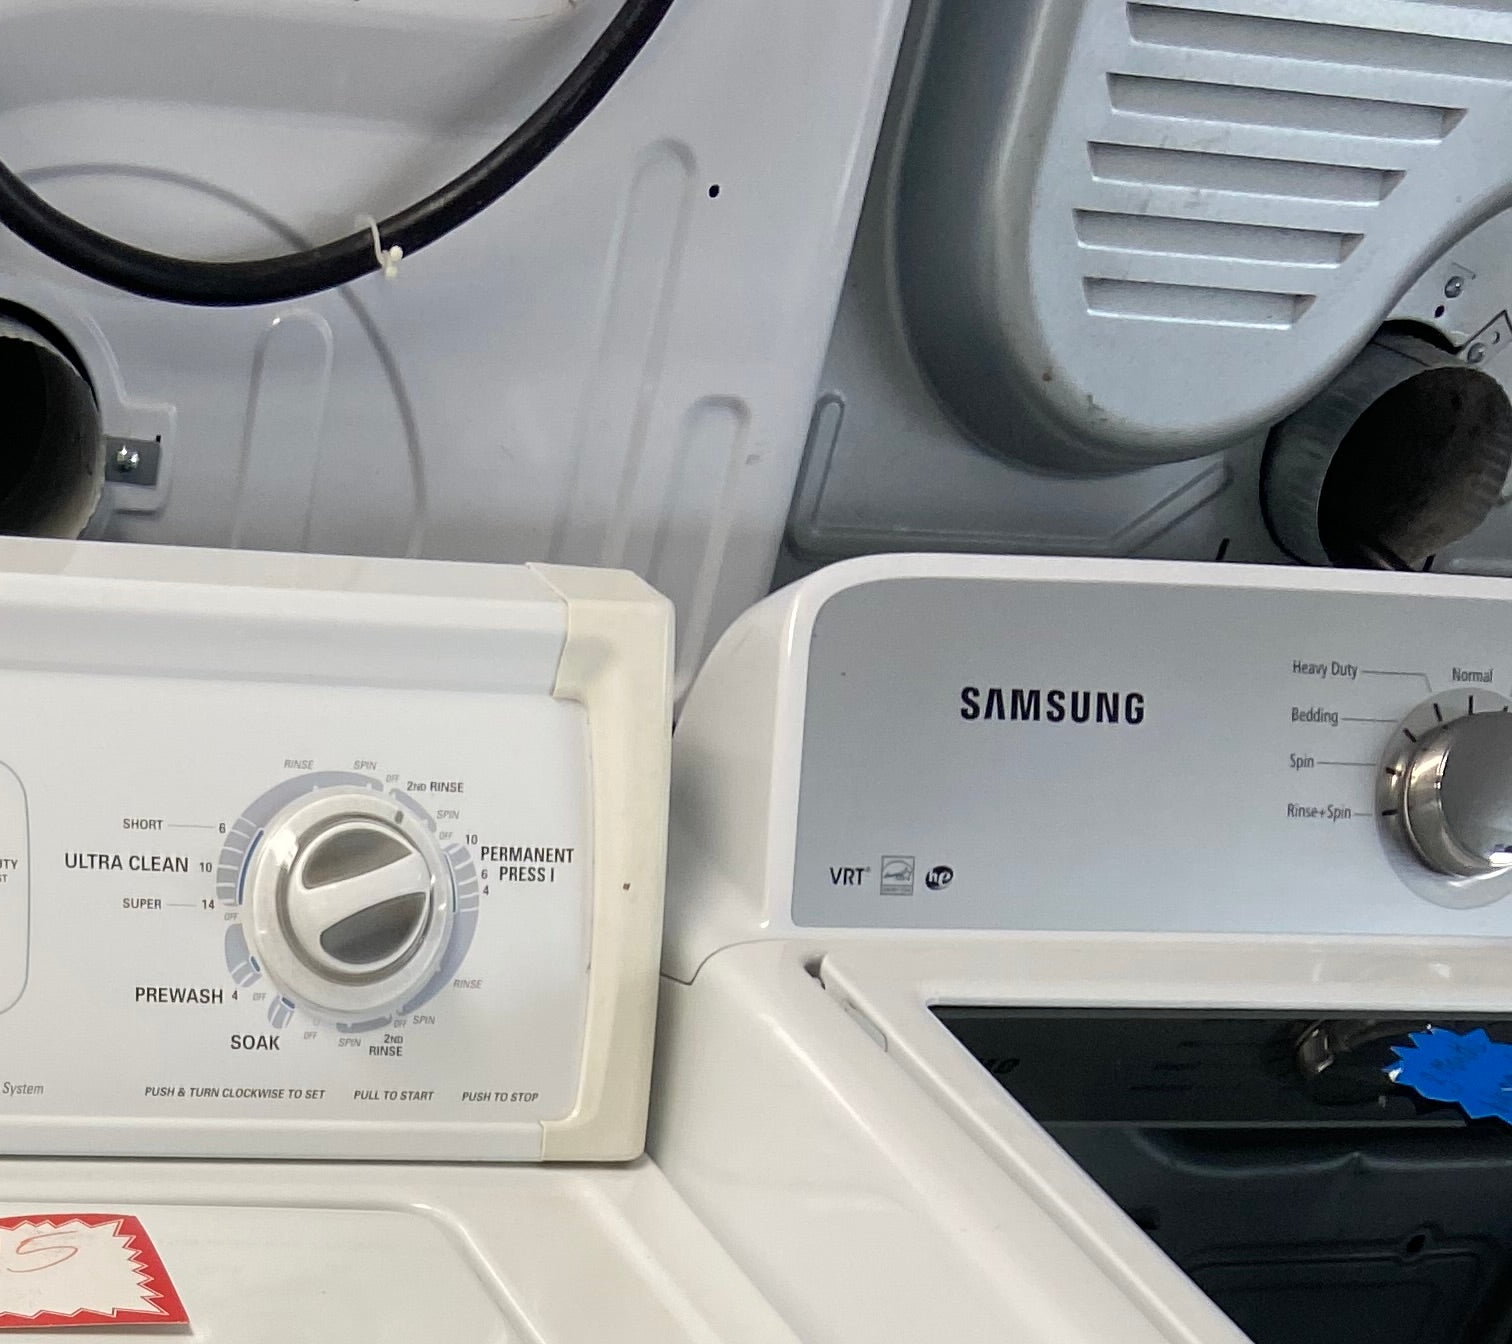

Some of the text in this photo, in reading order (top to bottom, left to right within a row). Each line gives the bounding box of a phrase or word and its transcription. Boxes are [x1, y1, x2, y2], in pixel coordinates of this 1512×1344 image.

[1292, 660, 1358, 680] Heavy Duty
[1452, 667, 1493, 682] Normal
[959, 686, 1145, 725] SAMSUNG
[1292, 707, 1338, 727] Bedding
[284, 760, 377, 770] RINSE SPIN
[1290, 753, 1314, 771] Spin
[407, 781, 464, 793] 2ND RINSE
[436, 810, 460, 819] SPIN
[1287, 803, 1351, 822] Rinse+Spin
[123, 819, 163, 830] SHORT
[465, 835, 478, 845] 10
[481, 846, 574, 863] PERMANENT
[65, 853, 212, 872] ULTRA CLEAN 10
[481, 869, 488, 879] 6
[500, 866, 545, 882] PRESS
[830, 867, 864, 885] VRT
[483, 885, 489, 895] 4
[123, 898, 215, 909] SUPER 14
[454, 980, 482, 989] RINSE
[136, 987, 223, 1004] PREWASH
[232, 991, 238, 1000] 4
[413, 1015, 435, 1025] SPIN
[230, 1035, 280, 1050] SOAK
[338, 1038, 361, 1047] SPIN
[384, 1034, 403, 1044] 2ND
[369, 1046, 403, 1056] RINSE
[2, 1082, 44, 1097] System
[145, 1087, 326, 1099] PUSH & TURN CLOCKWISE TO SET
[354, 1090, 434, 1100] PULL TO START
[462, 1092, 539, 1102] PUSH TO STOP
